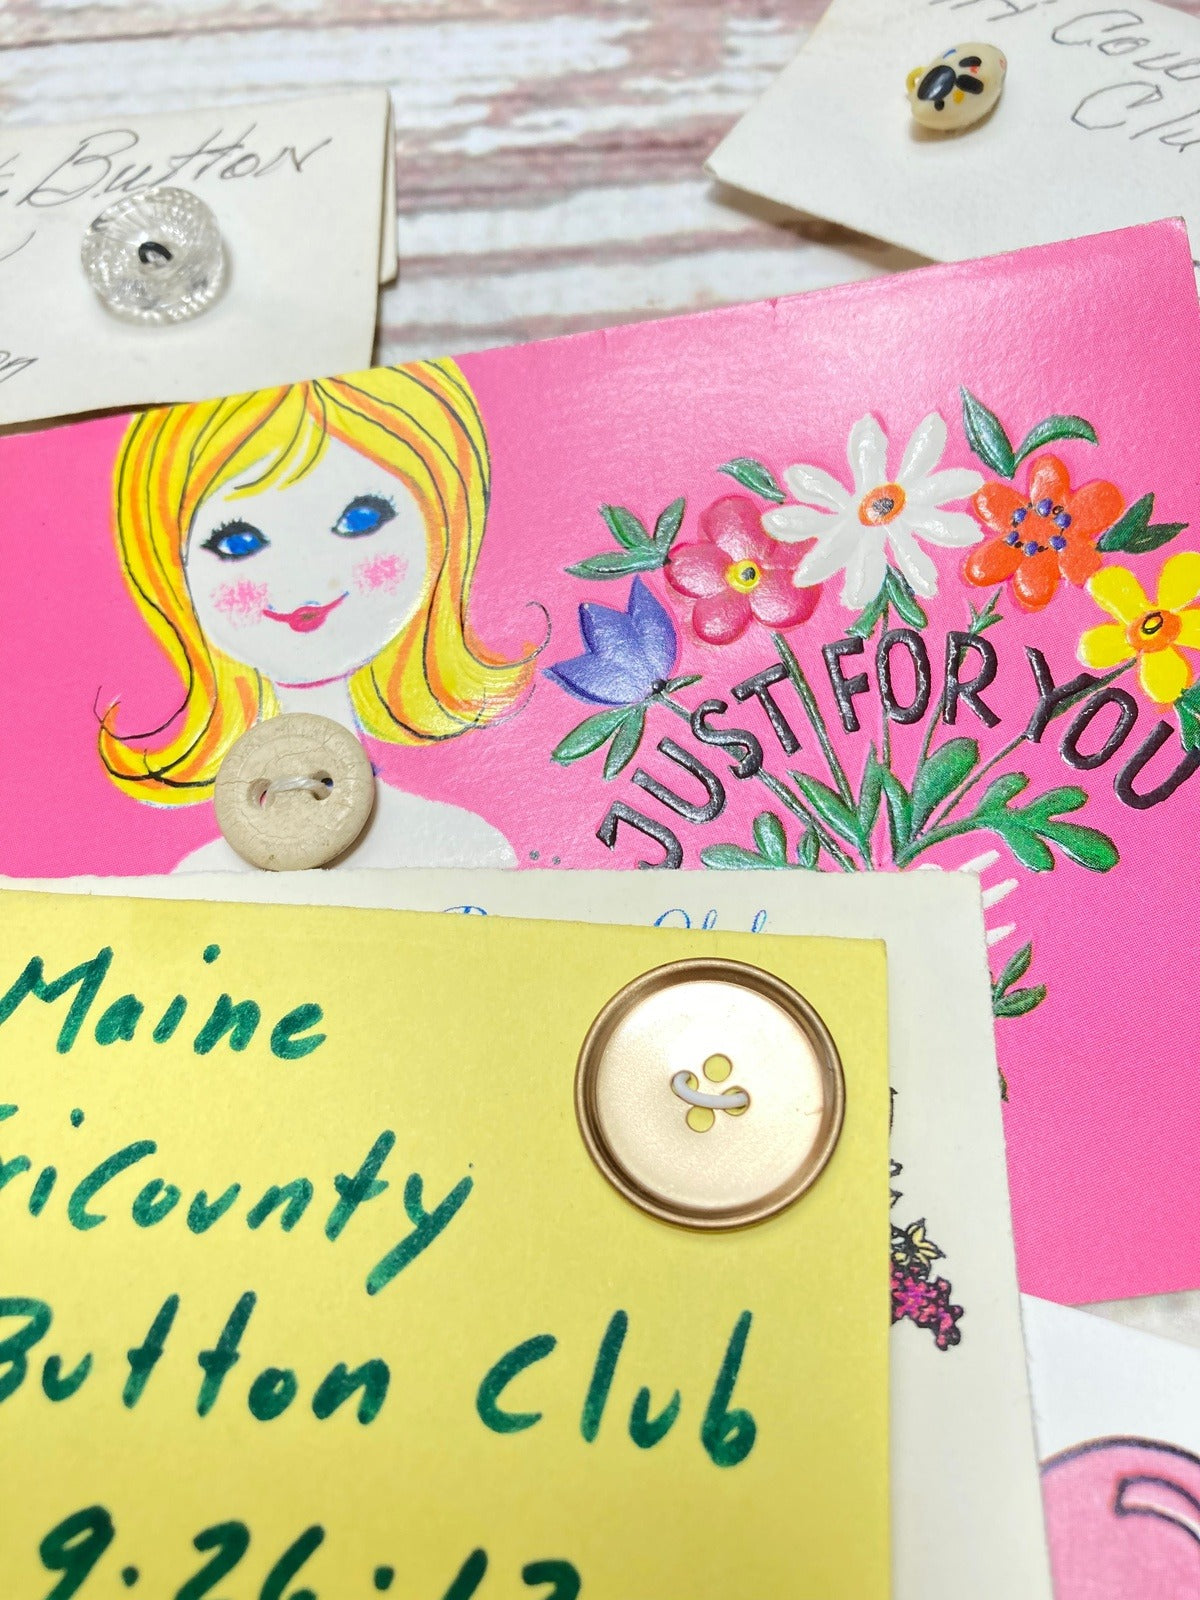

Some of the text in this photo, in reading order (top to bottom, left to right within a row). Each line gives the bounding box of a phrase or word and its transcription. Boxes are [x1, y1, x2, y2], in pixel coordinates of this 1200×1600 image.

[596, 631, 1200, 870] JUST FOR YOU
[0, 944, 327, 1060] Maine
[0, 1290, 757, 1468] Button Club
